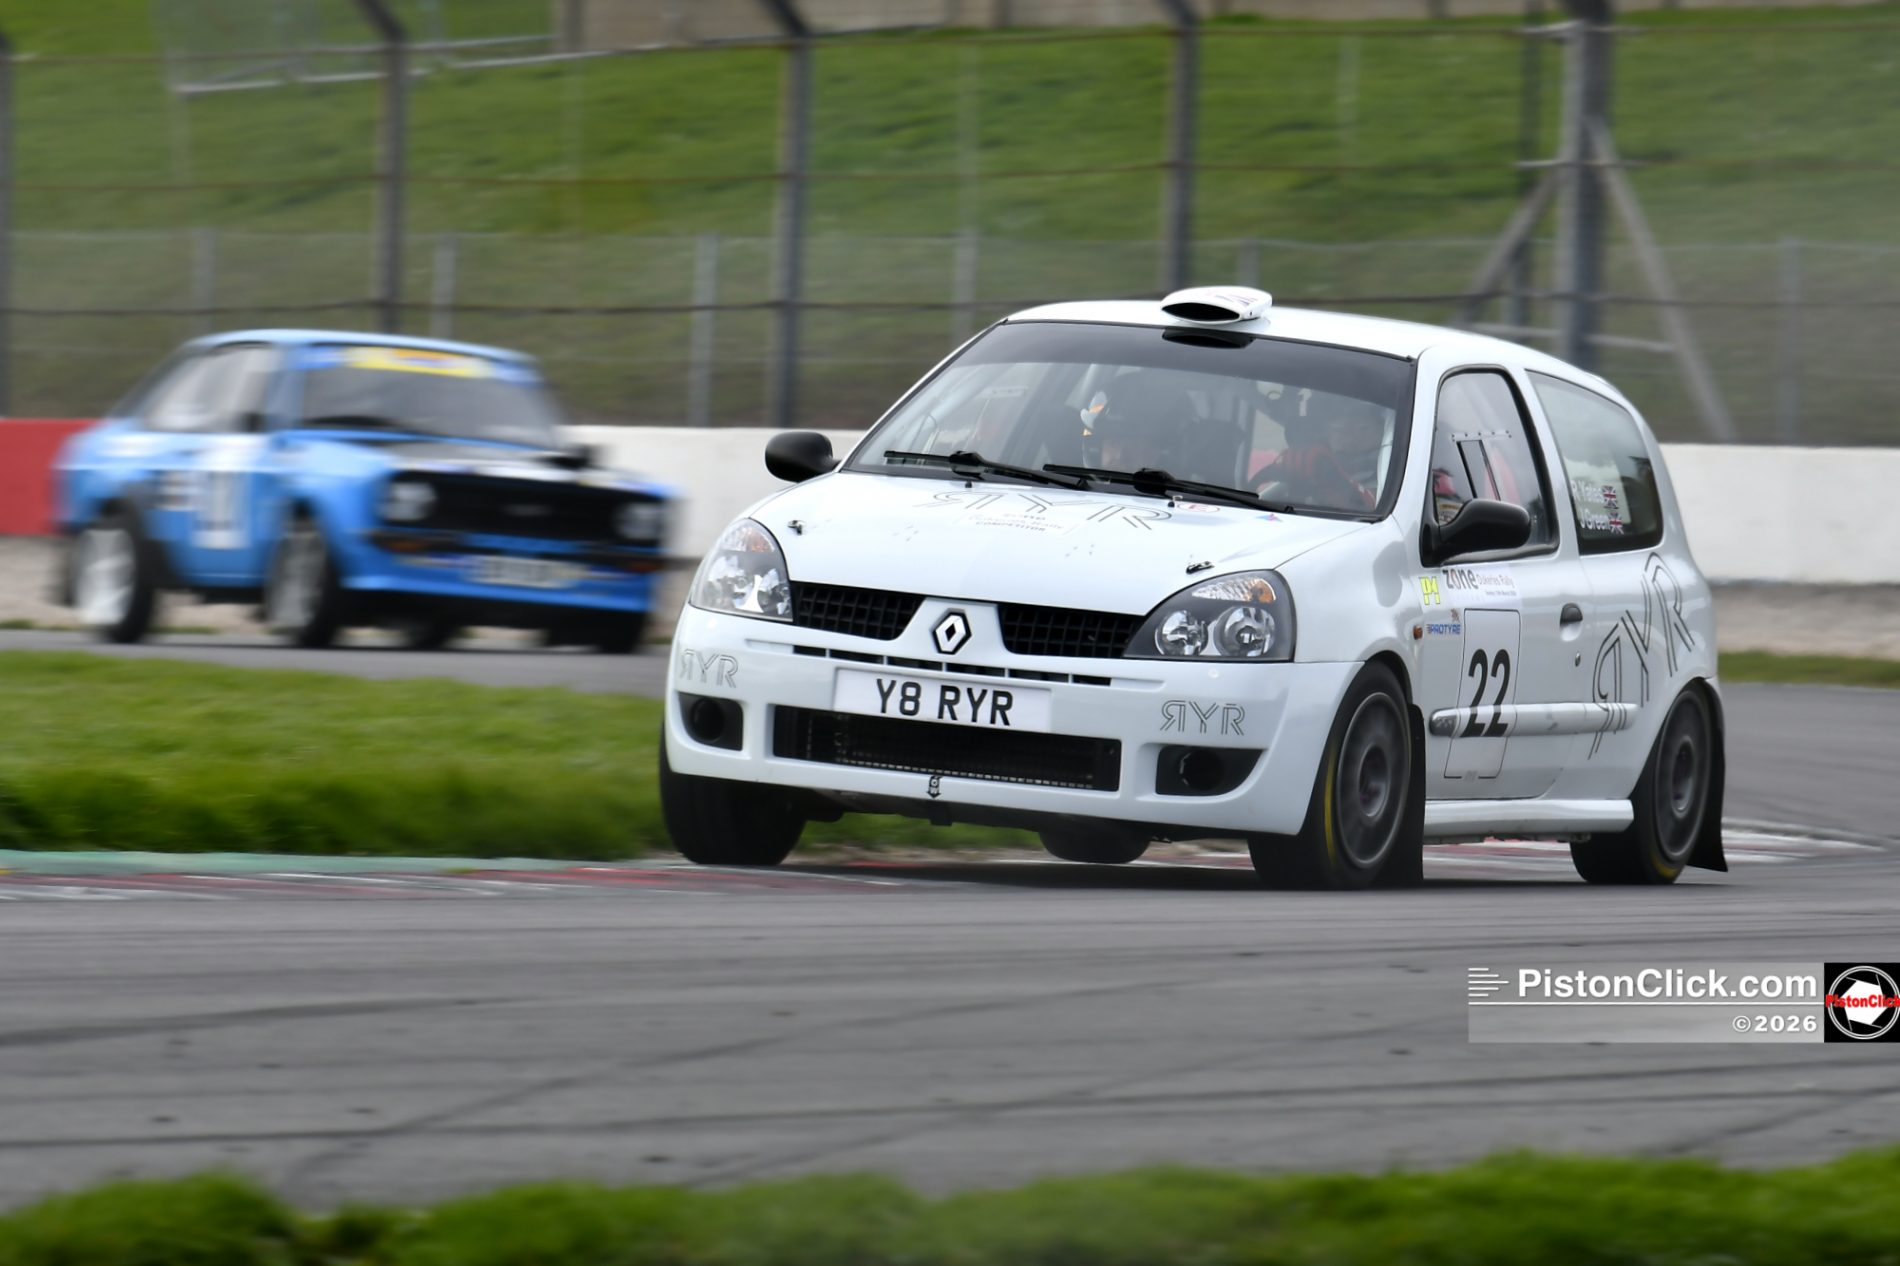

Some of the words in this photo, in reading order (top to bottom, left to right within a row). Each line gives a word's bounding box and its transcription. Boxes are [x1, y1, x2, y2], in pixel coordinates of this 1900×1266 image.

[1442, 568, 1479, 590] zone
[876, 678, 922, 717] Y8
[937, 684, 1014, 726] RYR
[1459, 648, 1510, 737] 22
